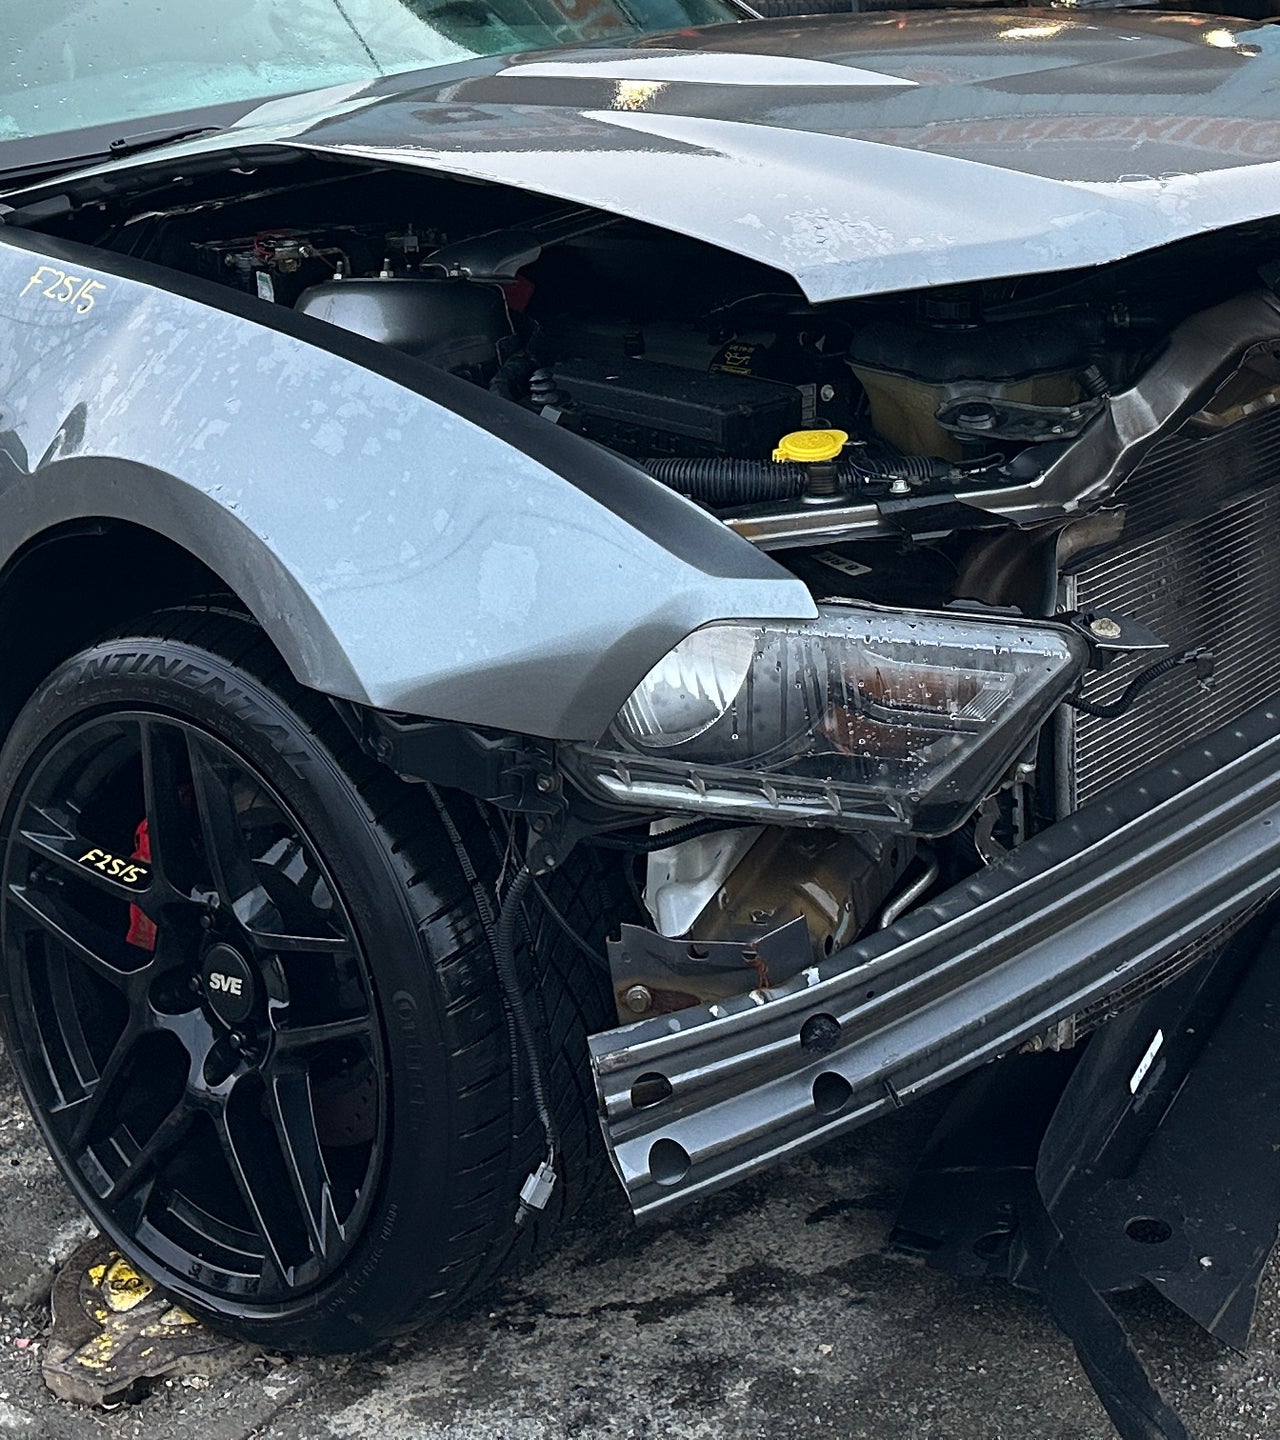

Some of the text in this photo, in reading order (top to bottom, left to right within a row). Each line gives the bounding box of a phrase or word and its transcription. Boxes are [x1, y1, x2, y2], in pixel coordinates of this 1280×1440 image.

[19, 265, 108, 315] F2515
[77, 848, 148, 884] F2515
[208, 971, 244, 997] SVE
